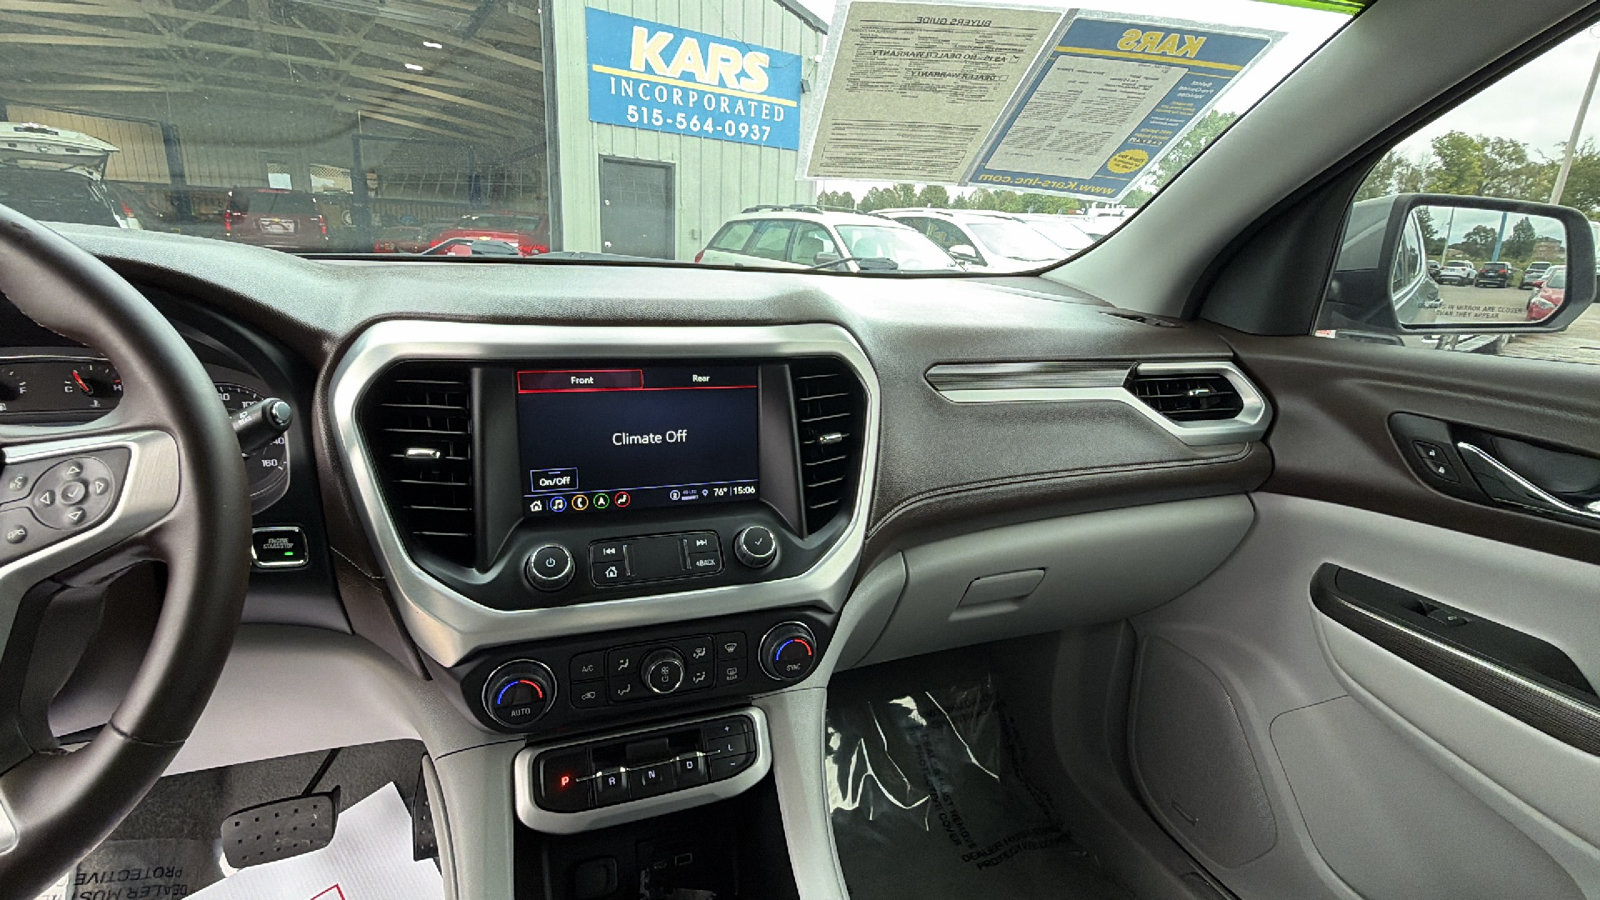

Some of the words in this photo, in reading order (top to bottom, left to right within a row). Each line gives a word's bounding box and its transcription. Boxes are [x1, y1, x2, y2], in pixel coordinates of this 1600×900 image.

[629, 25, 770, 93] KARS
[610, 77, 785, 123] INCORPORATED
[626, 104, 771, 142] 515-564-0937
[570, 376, 594, 385] Front
[692, 374, 710, 383] Rear
[64, 385, 73, 393] C
[112, 384, 122, 392] H
[612, 431, 663, 446] Climate
[666, 429, 688, 443] Off
[261, 459, 278, 468] 160
[539, 476, 571, 487] On/Off
[713, 487, 728, 497] 76°
[733, 486, 756, 495] 15:06
[699, 557, 716, 567] BACK
[582, 664, 594, 674] A/C
[786, 663, 801, 672] SYNC
[511, 707, 531, 718] AUTO
[686, 760, 693, 769] D
[648, 770, 656, 779] N
[561, 776, 570, 786] P
[608, 776, 616, 786] R
[75, 866, 183, 886] PROTECTIVE
[127, 884, 188, 899] DEALER
